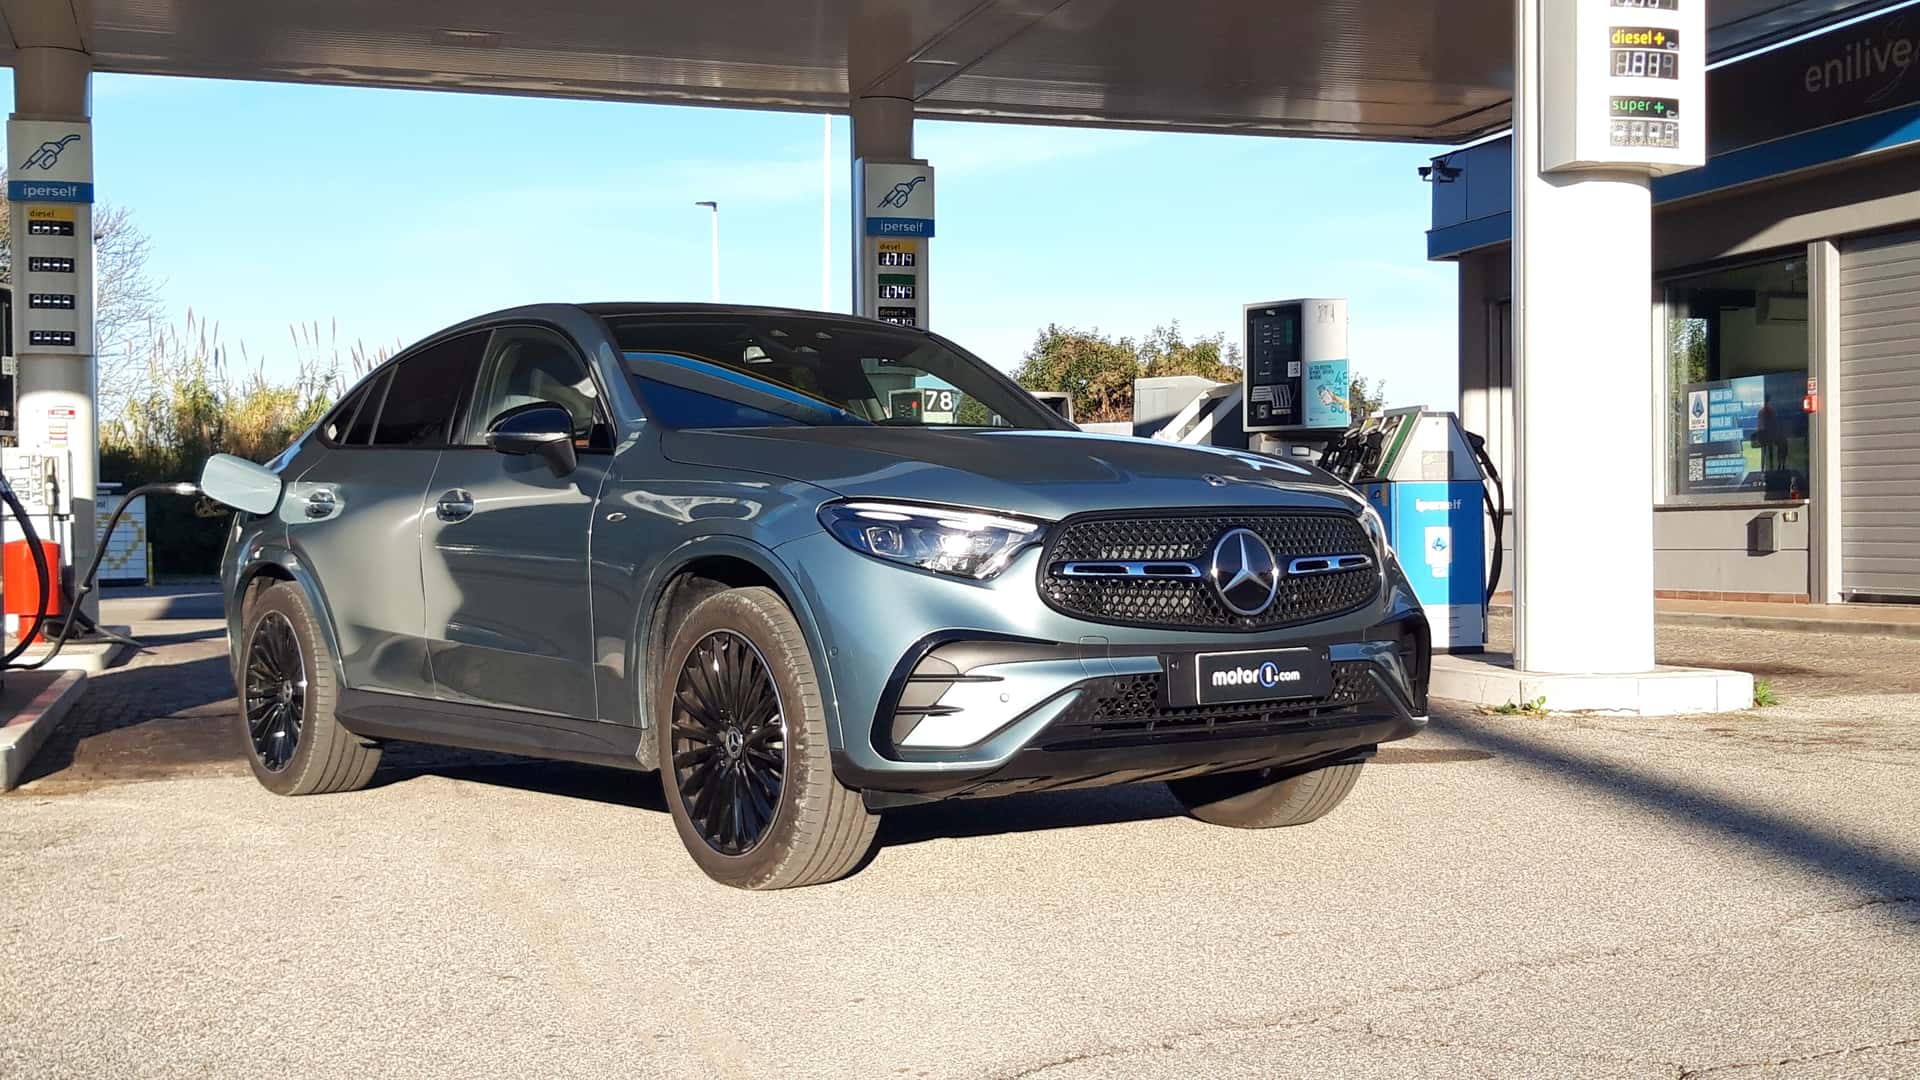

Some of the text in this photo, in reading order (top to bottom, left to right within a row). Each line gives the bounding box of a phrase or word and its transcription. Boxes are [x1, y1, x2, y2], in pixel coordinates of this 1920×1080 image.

[1805, 37, 1912, 93] enilive
[1612, 99, 1650, 113] super
[23, 184, 78, 198] iperself
[29, 209, 55, 218] diesel
[880, 218, 923, 233] iperself
[879, 242, 901, 250] diesel
[925, 390, 953, 411] 78
[1212, 662, 1300, 687] motor1.com
